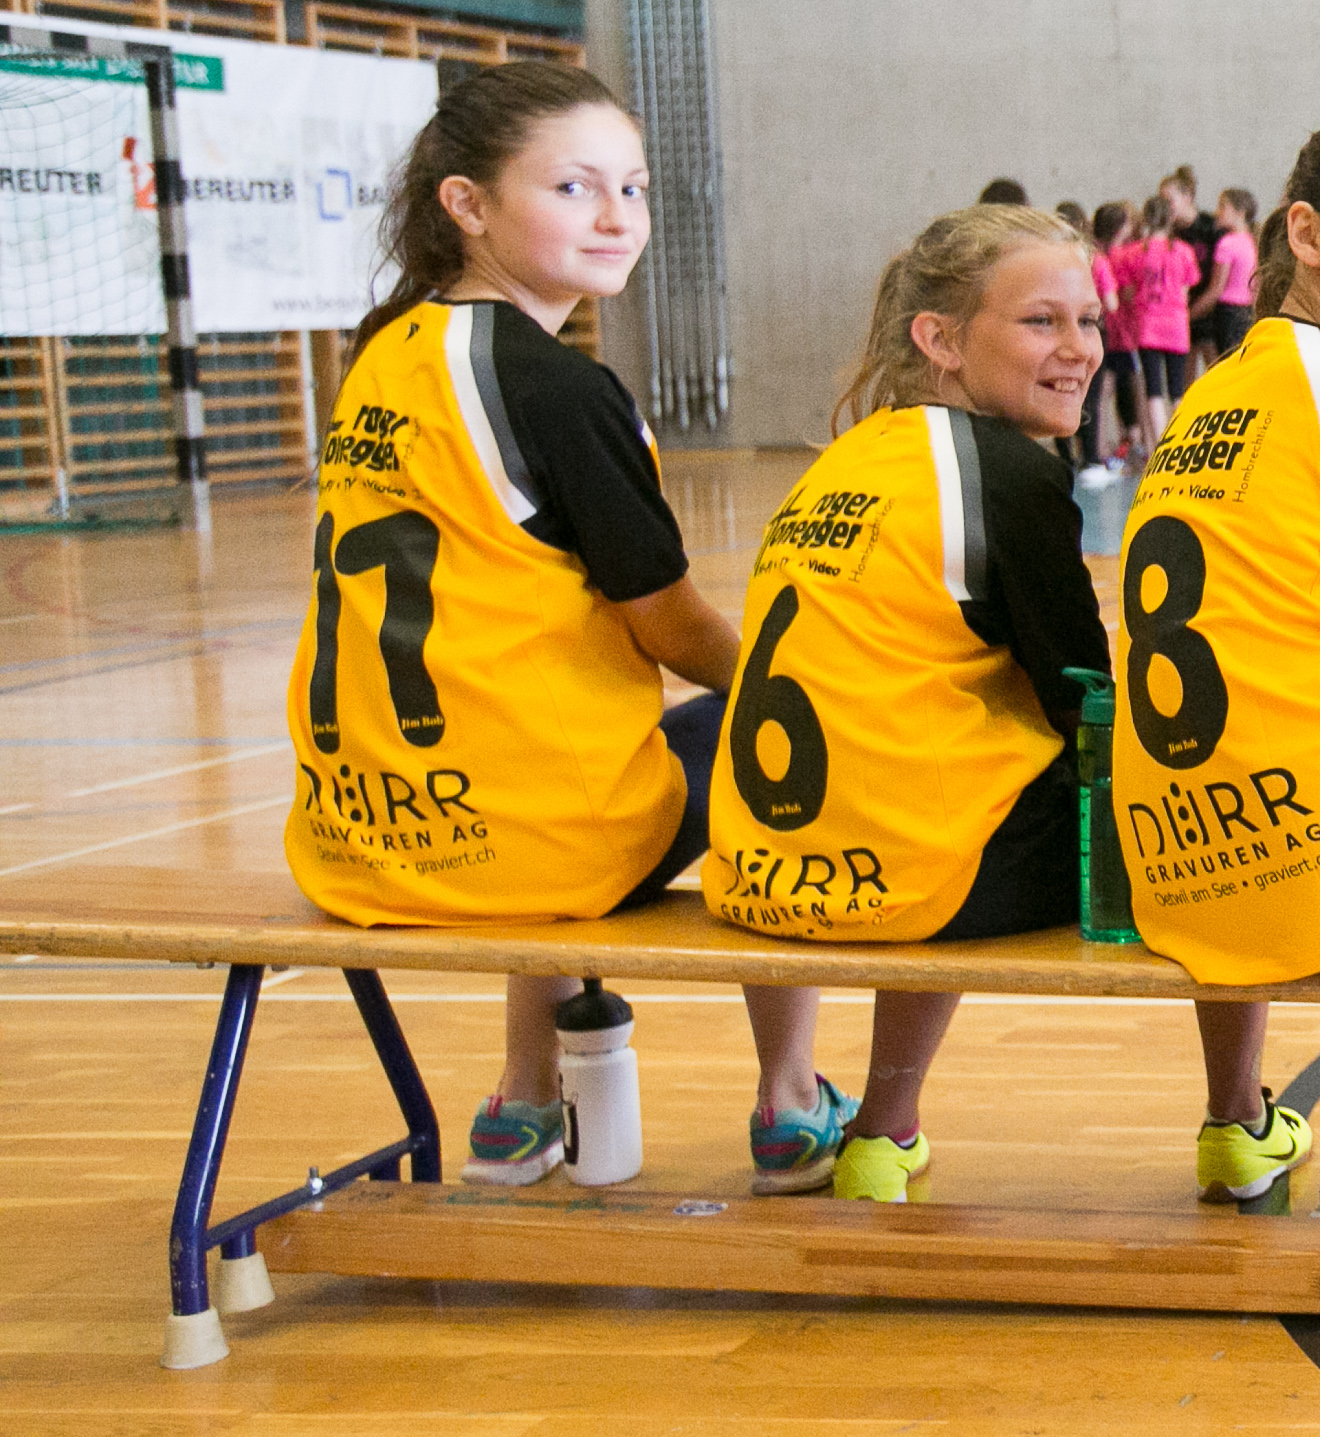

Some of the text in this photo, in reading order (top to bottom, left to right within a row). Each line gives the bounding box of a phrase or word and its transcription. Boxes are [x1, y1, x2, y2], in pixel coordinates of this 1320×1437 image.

[1182, 407, 1260, 441] roger
[1232, 409, 1275, 503] Hombrechtikon
[1188, 484, 1225, 500] Video
[808, 559, 841, 577] Video
[1123, 515, 1230, 770] 8
[730, 585, 828, 832] 6
[452, 820, 488, 844] AG
[415, 846, 496, 876] graviert.ch
[1145, 841, 1270, 884] GRAVUREN
[1154, 889, 1190, 908] Oetwil
[1191, 886, 1212, 904] am
[1211, 881, 1239, 900] See
